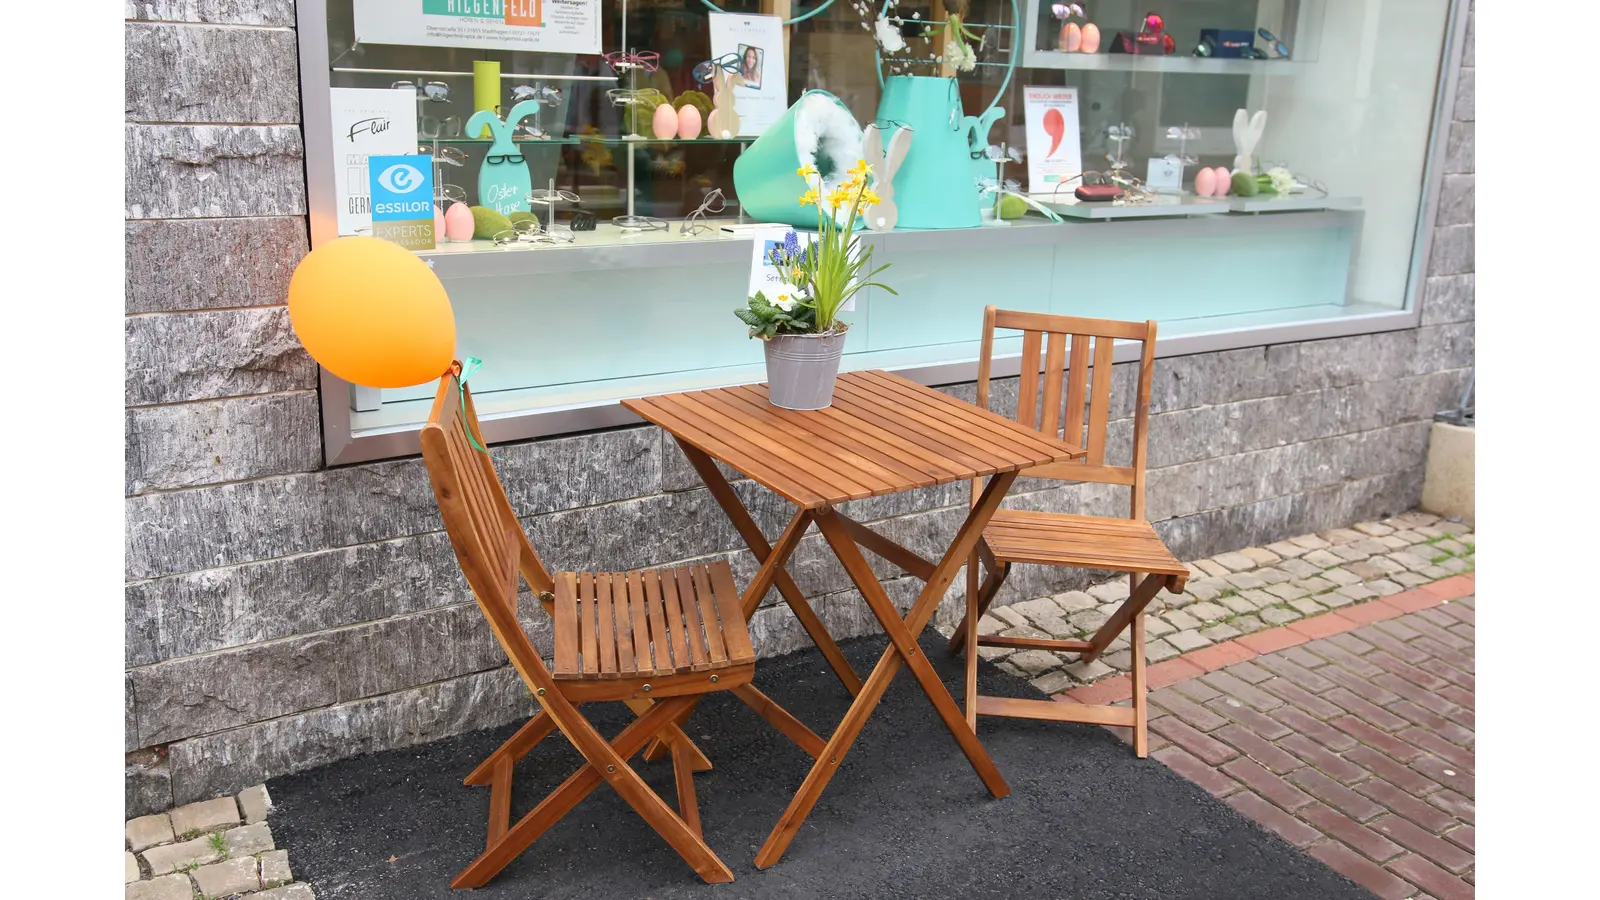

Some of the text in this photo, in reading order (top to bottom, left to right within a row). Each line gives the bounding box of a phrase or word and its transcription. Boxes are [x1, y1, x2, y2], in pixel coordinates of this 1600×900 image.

[346, 117, 390, 142] Flair
[487, 183, 518, 203] Oster
[376, 224, 432, 239] EXPERTS
